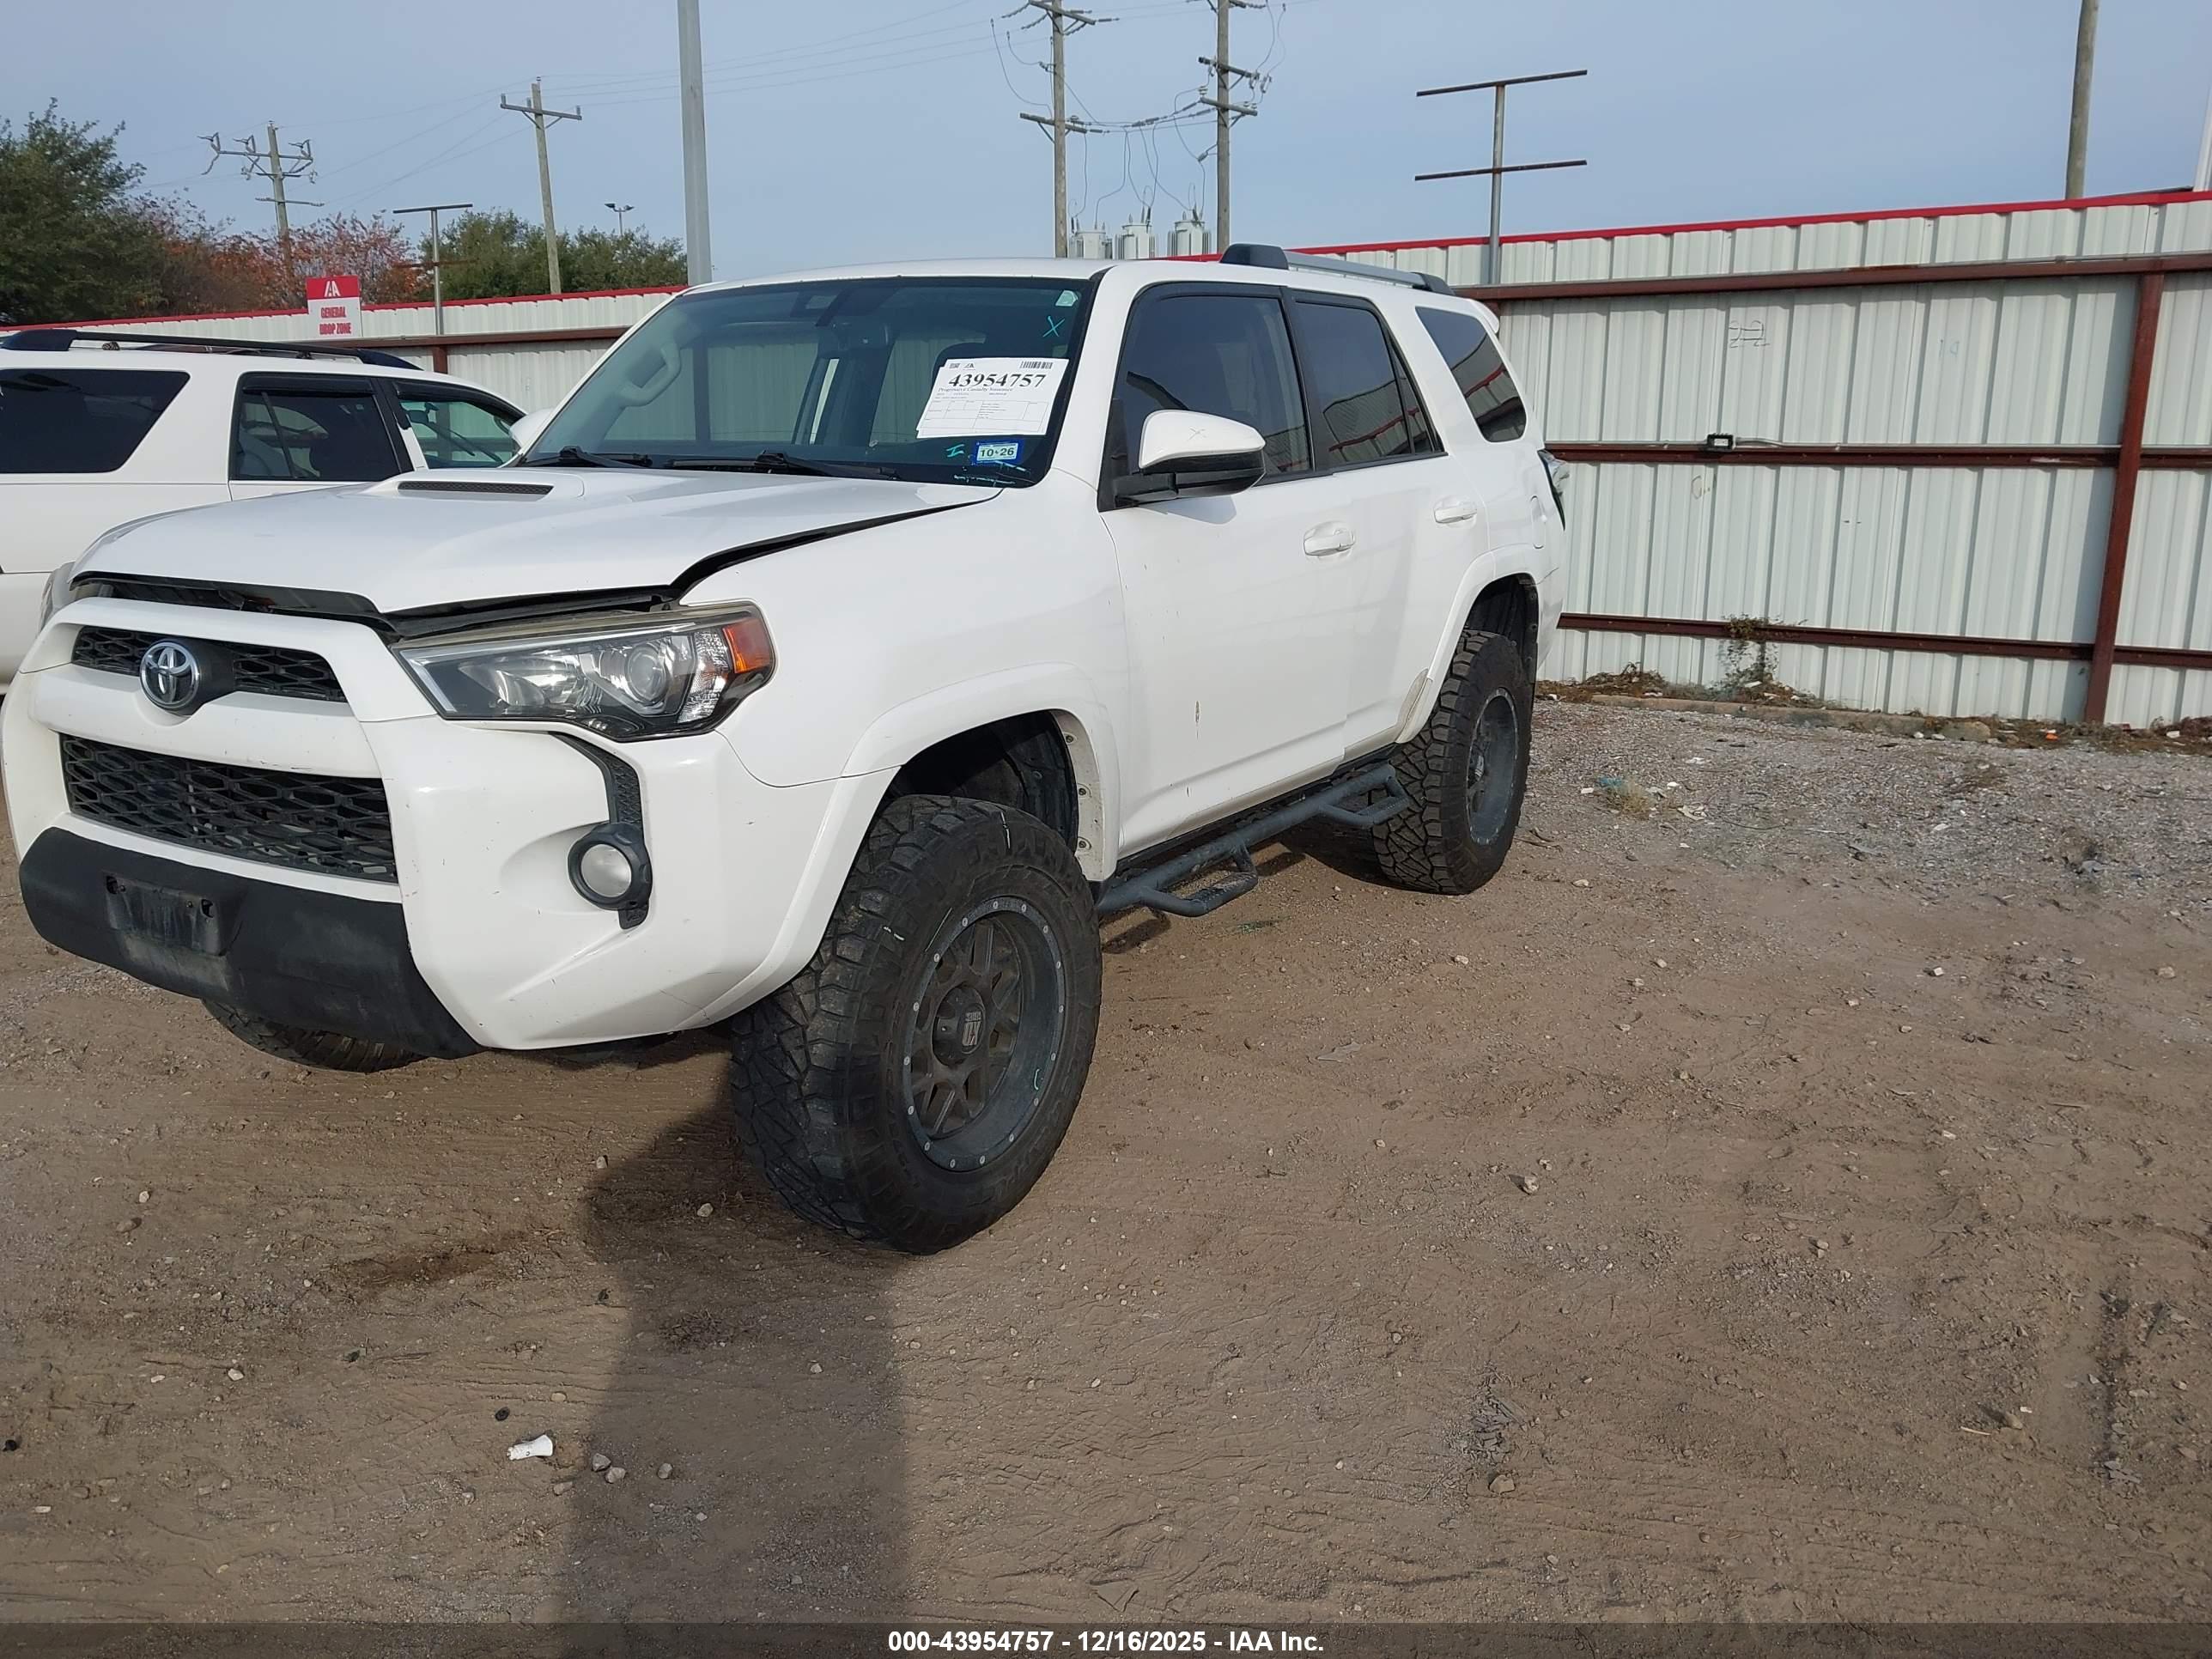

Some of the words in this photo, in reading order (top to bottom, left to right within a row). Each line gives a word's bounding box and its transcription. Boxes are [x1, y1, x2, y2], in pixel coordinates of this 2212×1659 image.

[321, 306, 346, 319] GENERAL
[319, 323, 336, 335] DROP
[337, 322, 351, 334] ZONE
[948, 374, 1047, 387] 43954757
